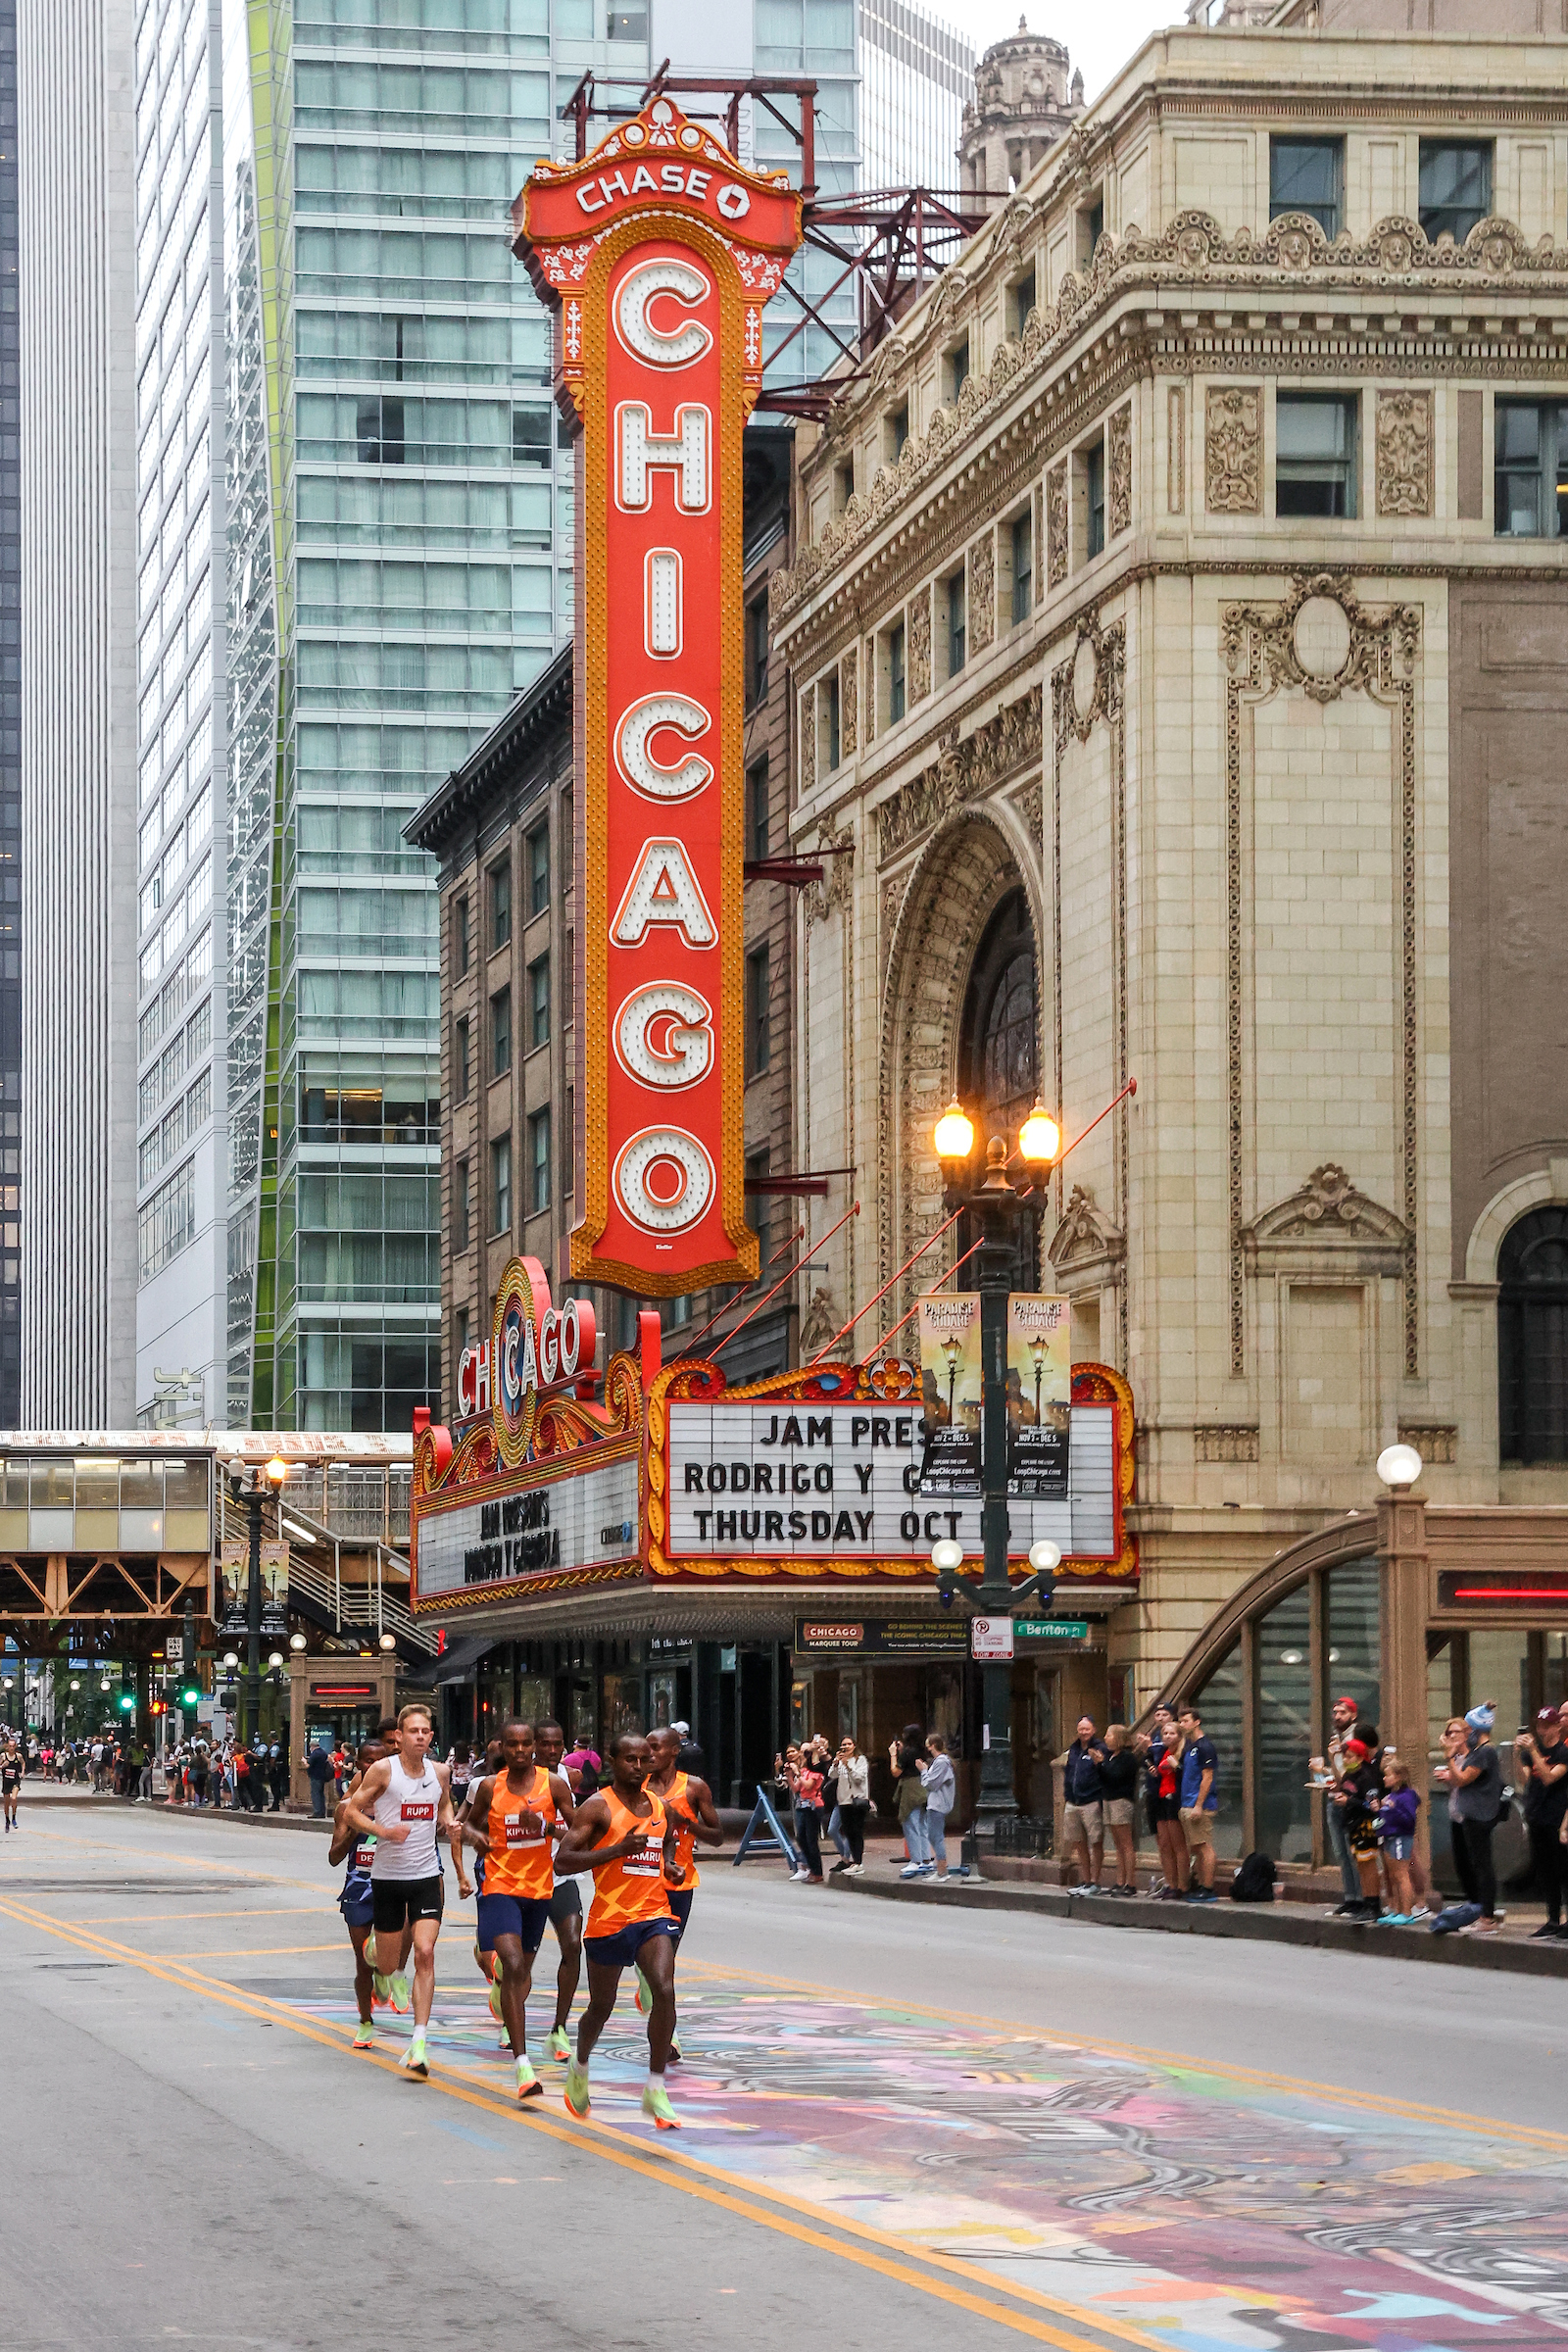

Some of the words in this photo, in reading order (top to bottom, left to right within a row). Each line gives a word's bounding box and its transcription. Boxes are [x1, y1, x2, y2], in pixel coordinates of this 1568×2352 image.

[575, 164, 712, 213] CHASE
[609, 257, 719, 1238] CHICAGO
[924, 1302, 974, 1315] PARADISE
[1013, 1301, 1061, 1316] PARADISE
[458, 1298, 580, 1417] CHICAGO
[760, 1415, 832, 1447] JAM
[684, 1462, 833, 1494] RODRIGO
[854, 1463, 874, 1494] Y
[926, 1467, 975, 1476] LoopChicago.com
[694, 1509, 874, 1542] THURSDAY
[901, 1510, 962, 1541] OCT
[809, 1628, 858, 1637] CHICAGO
[1026, 1623, 1068, 1636] Benton
[407, 1806, 429, 1816] RUPP
